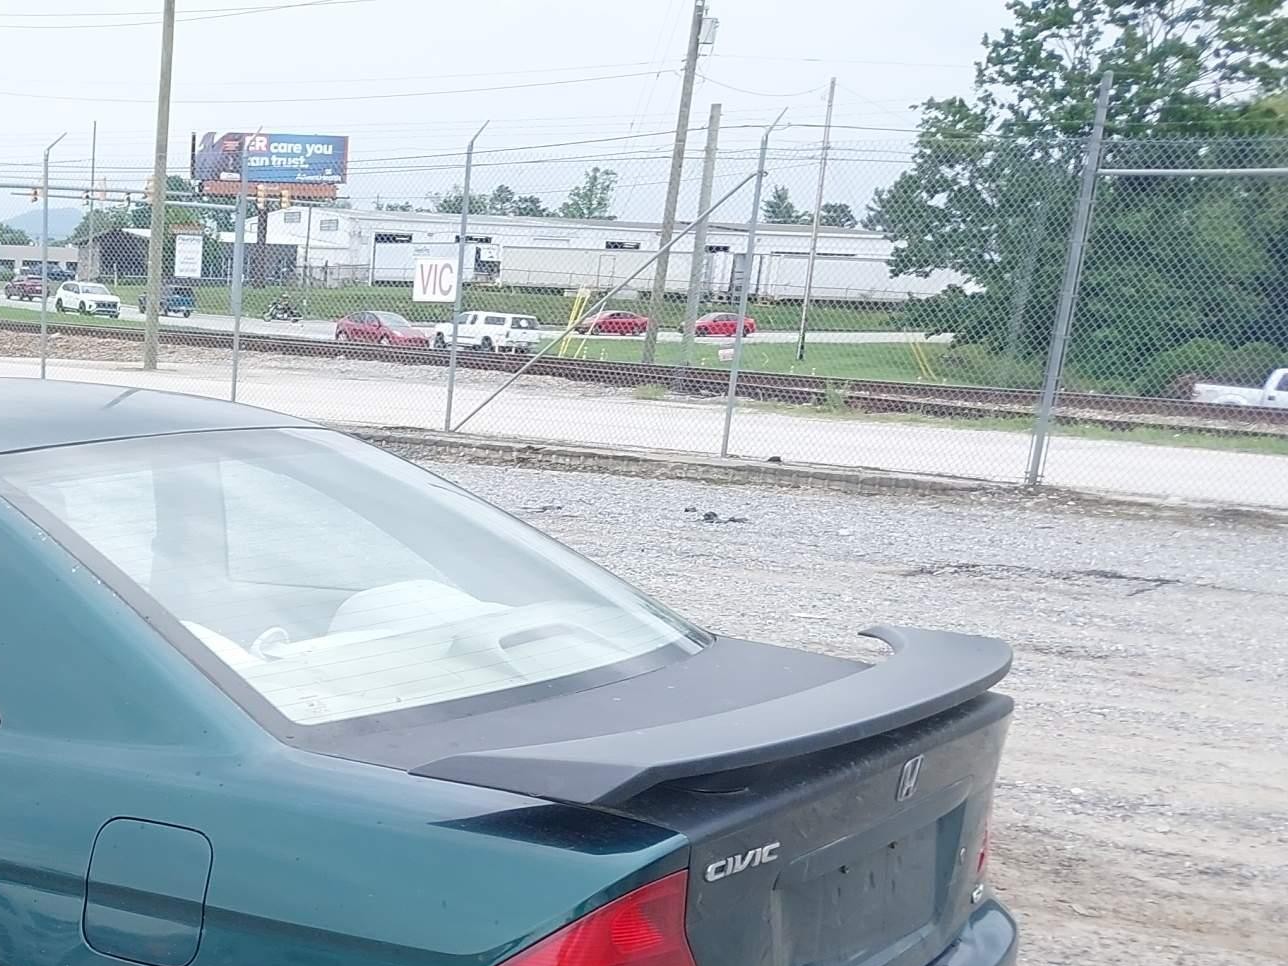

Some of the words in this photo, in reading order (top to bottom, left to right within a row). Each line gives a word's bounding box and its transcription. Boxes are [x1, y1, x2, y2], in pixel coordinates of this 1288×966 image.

[270, 142, 302, 153] care
[305, 143, 333, 156] you
[420, 263, 454, 296] VIC
[705, 842, 780, 882] CIVIC
